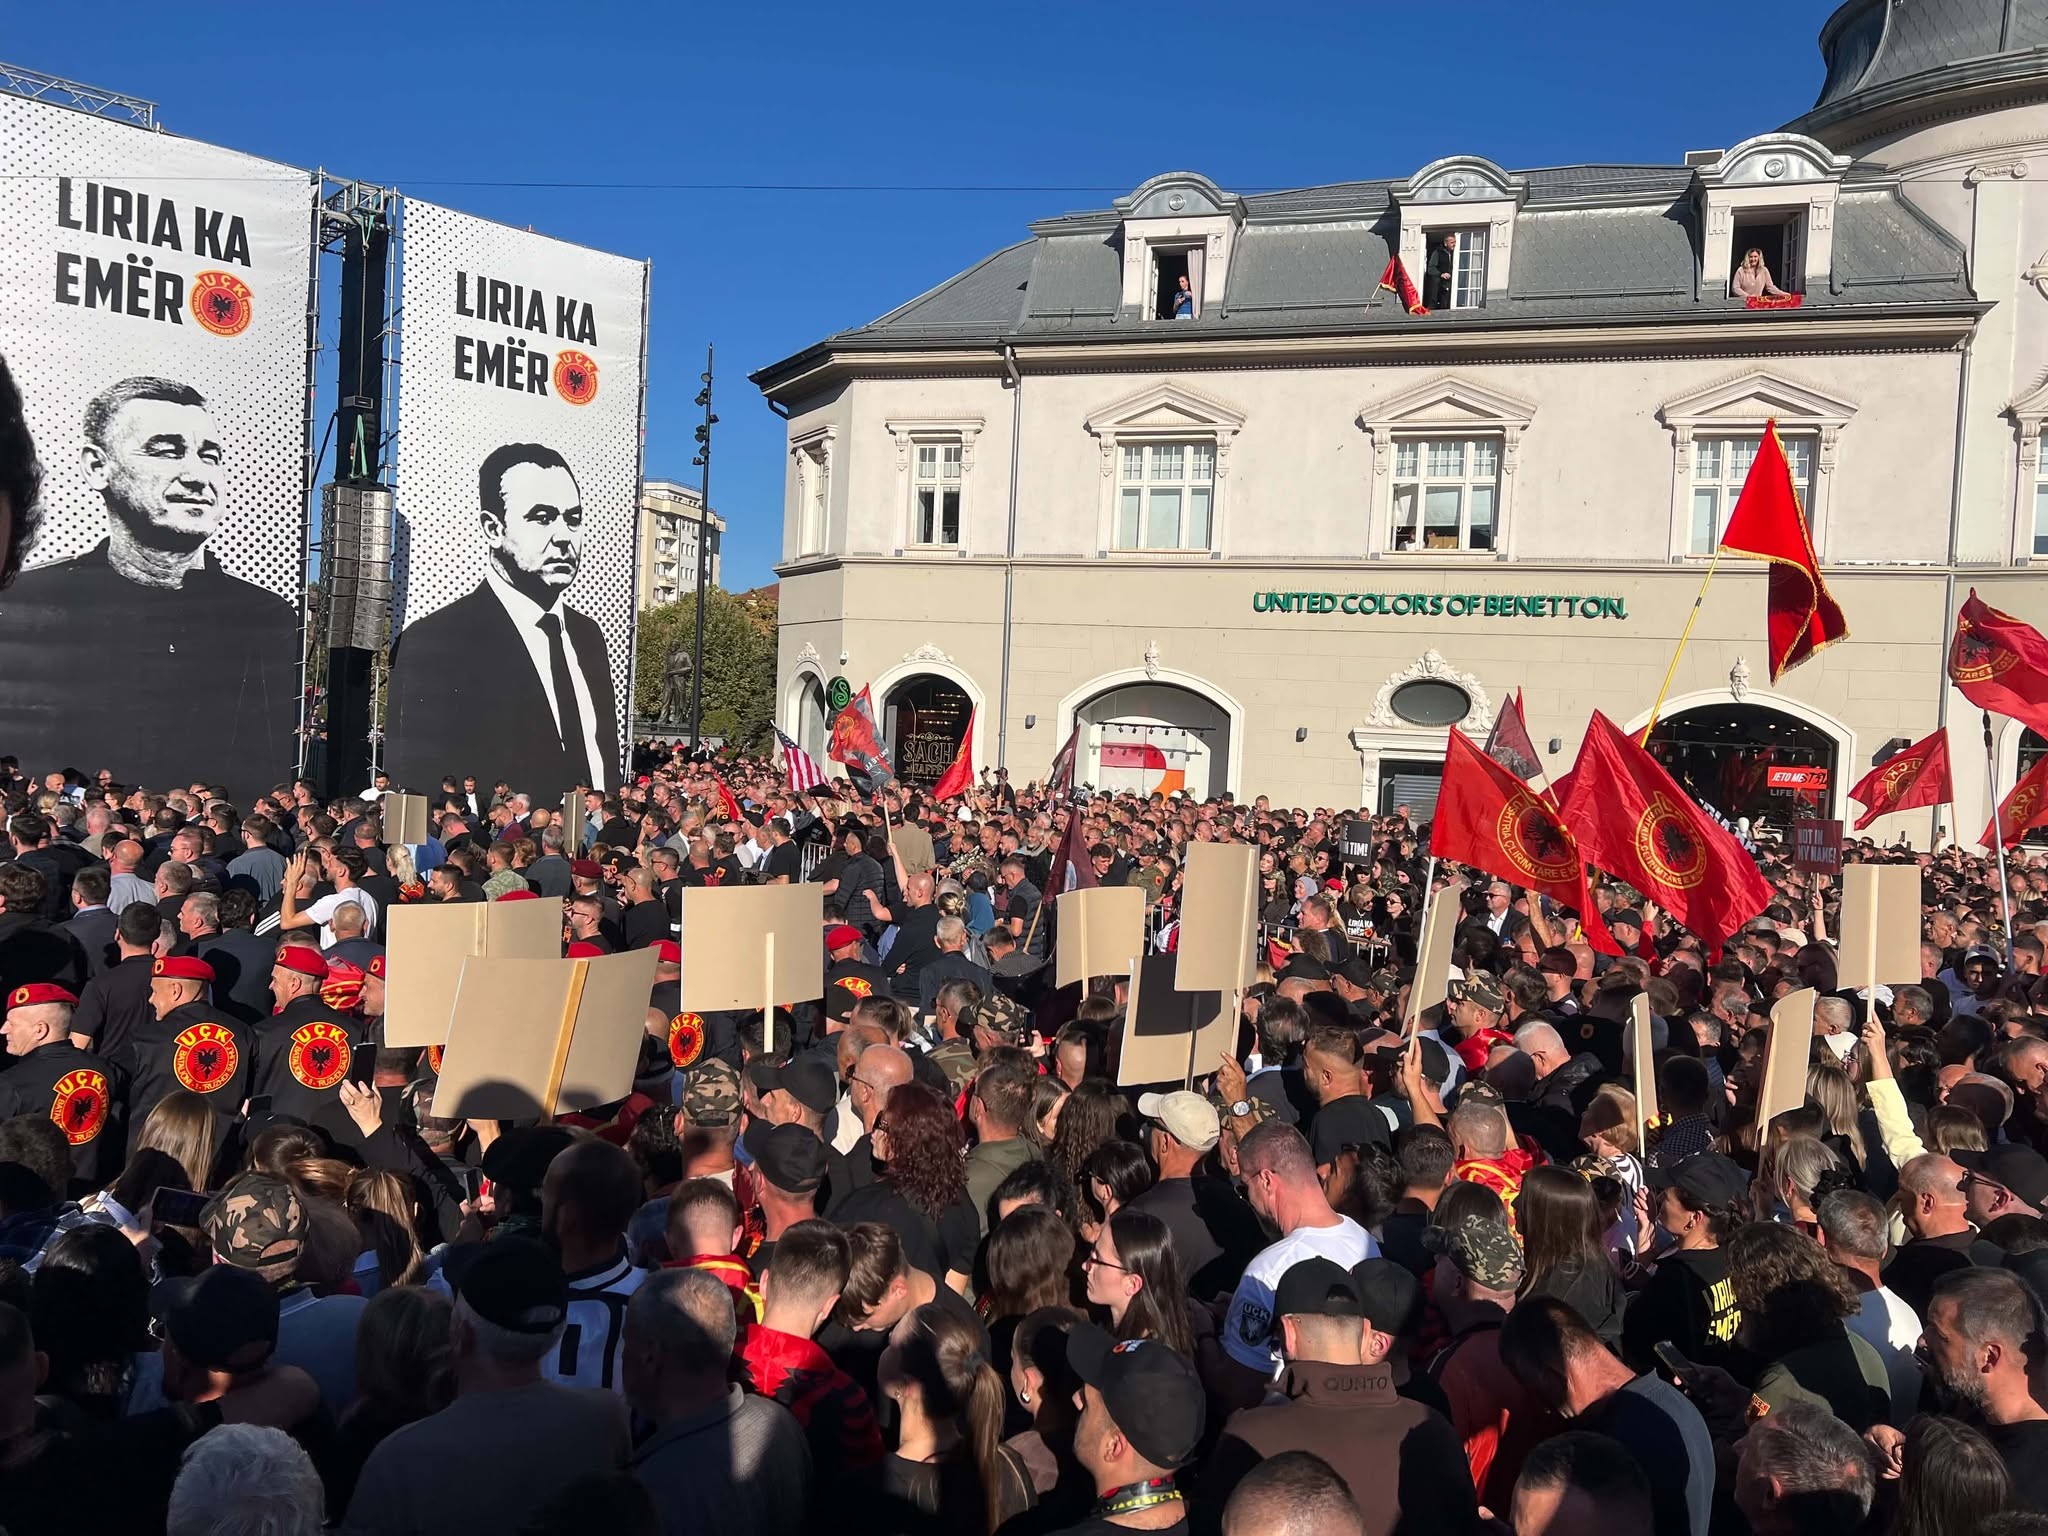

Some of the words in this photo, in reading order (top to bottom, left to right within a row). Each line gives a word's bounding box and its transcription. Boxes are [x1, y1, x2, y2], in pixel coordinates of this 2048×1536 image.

[58, 177, 183, 251] LIRIA
[195, 206, 251, 268] KA
[56, 250, 183, 325] EMËR
[203, 274, 247, 298] UÇK
[456, 270, 547, 334] LIRIA
[556, 295, 597, 346] KA
[454, 335, 548, 396] EMËR
[1254, 592, 1338, 613] UNITED
[1341, 593, 1444, 616] COLORS
[1447, 594, 1482, 616] OF
[844, 978, 867, 991] ÇK
[296, 1024, 343, 1043] UÇK
[671, 1014, 701, 1031] UÇK
[180, 1025, 229, 1046] UÇK
[58, 1071, 103, 1094] UÇK
